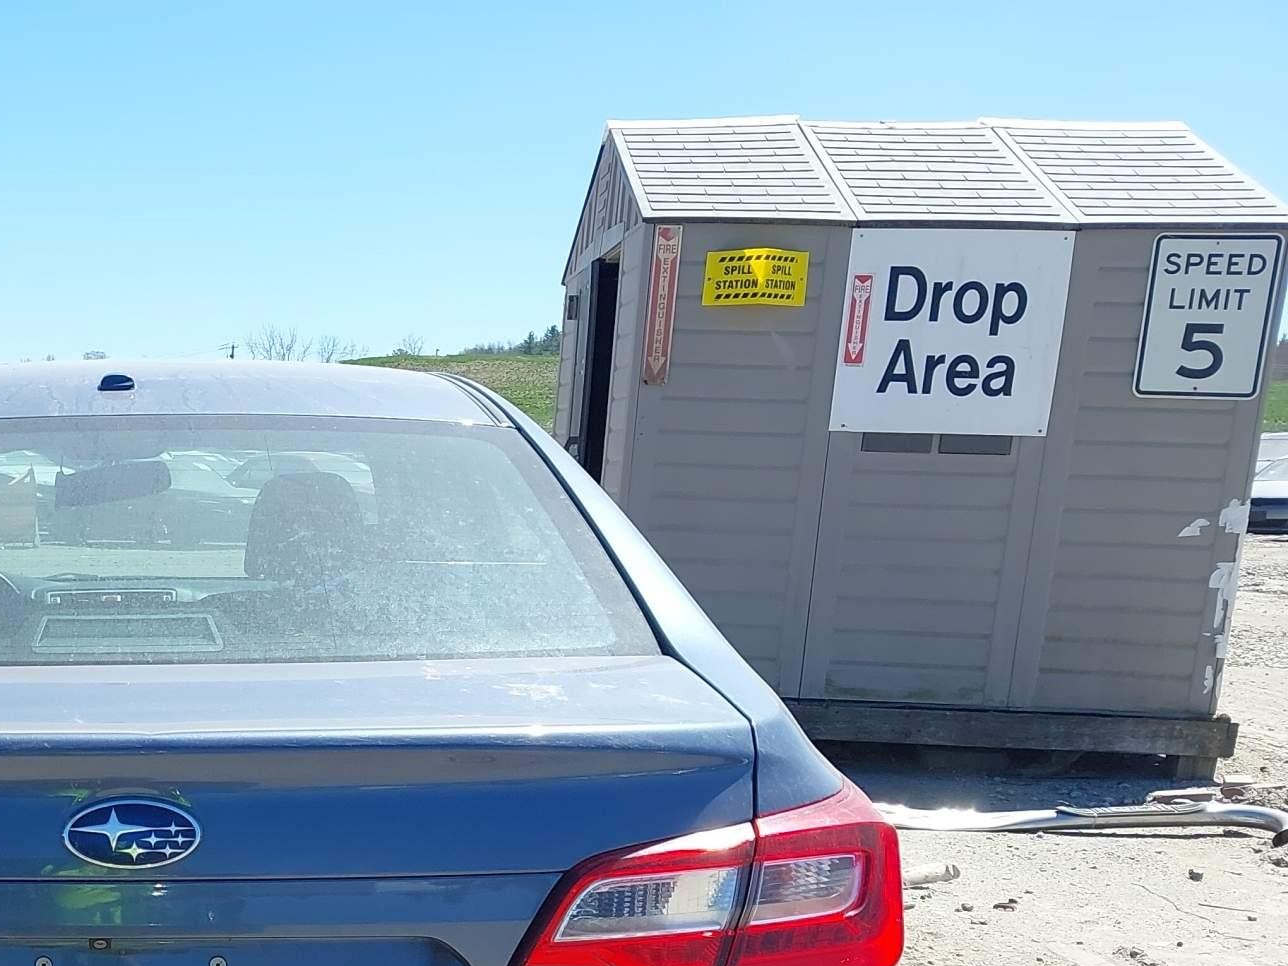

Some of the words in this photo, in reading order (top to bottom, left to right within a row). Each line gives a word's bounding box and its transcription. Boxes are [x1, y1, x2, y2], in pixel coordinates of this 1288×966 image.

[658, 243, 677, 255] FIRE
[723, 264, 753, 276] SPILL
[771, 264, 792, 276] SPILL
[1163, 252, 1268, 276] SPEED
[714, 278, 759, 290] STATION
[764, 279, 796, 291] STATION
[854, 284, 871, 293] FIRE
[884, 266, 1028, 336] Drop
[1168, 287, 1252, 311] LIMIT
[653, 257, 670, 363] EXTINGUISHER
[1175, 322, 1225, 380] 5
[875, 339, 1016, 397] Area
